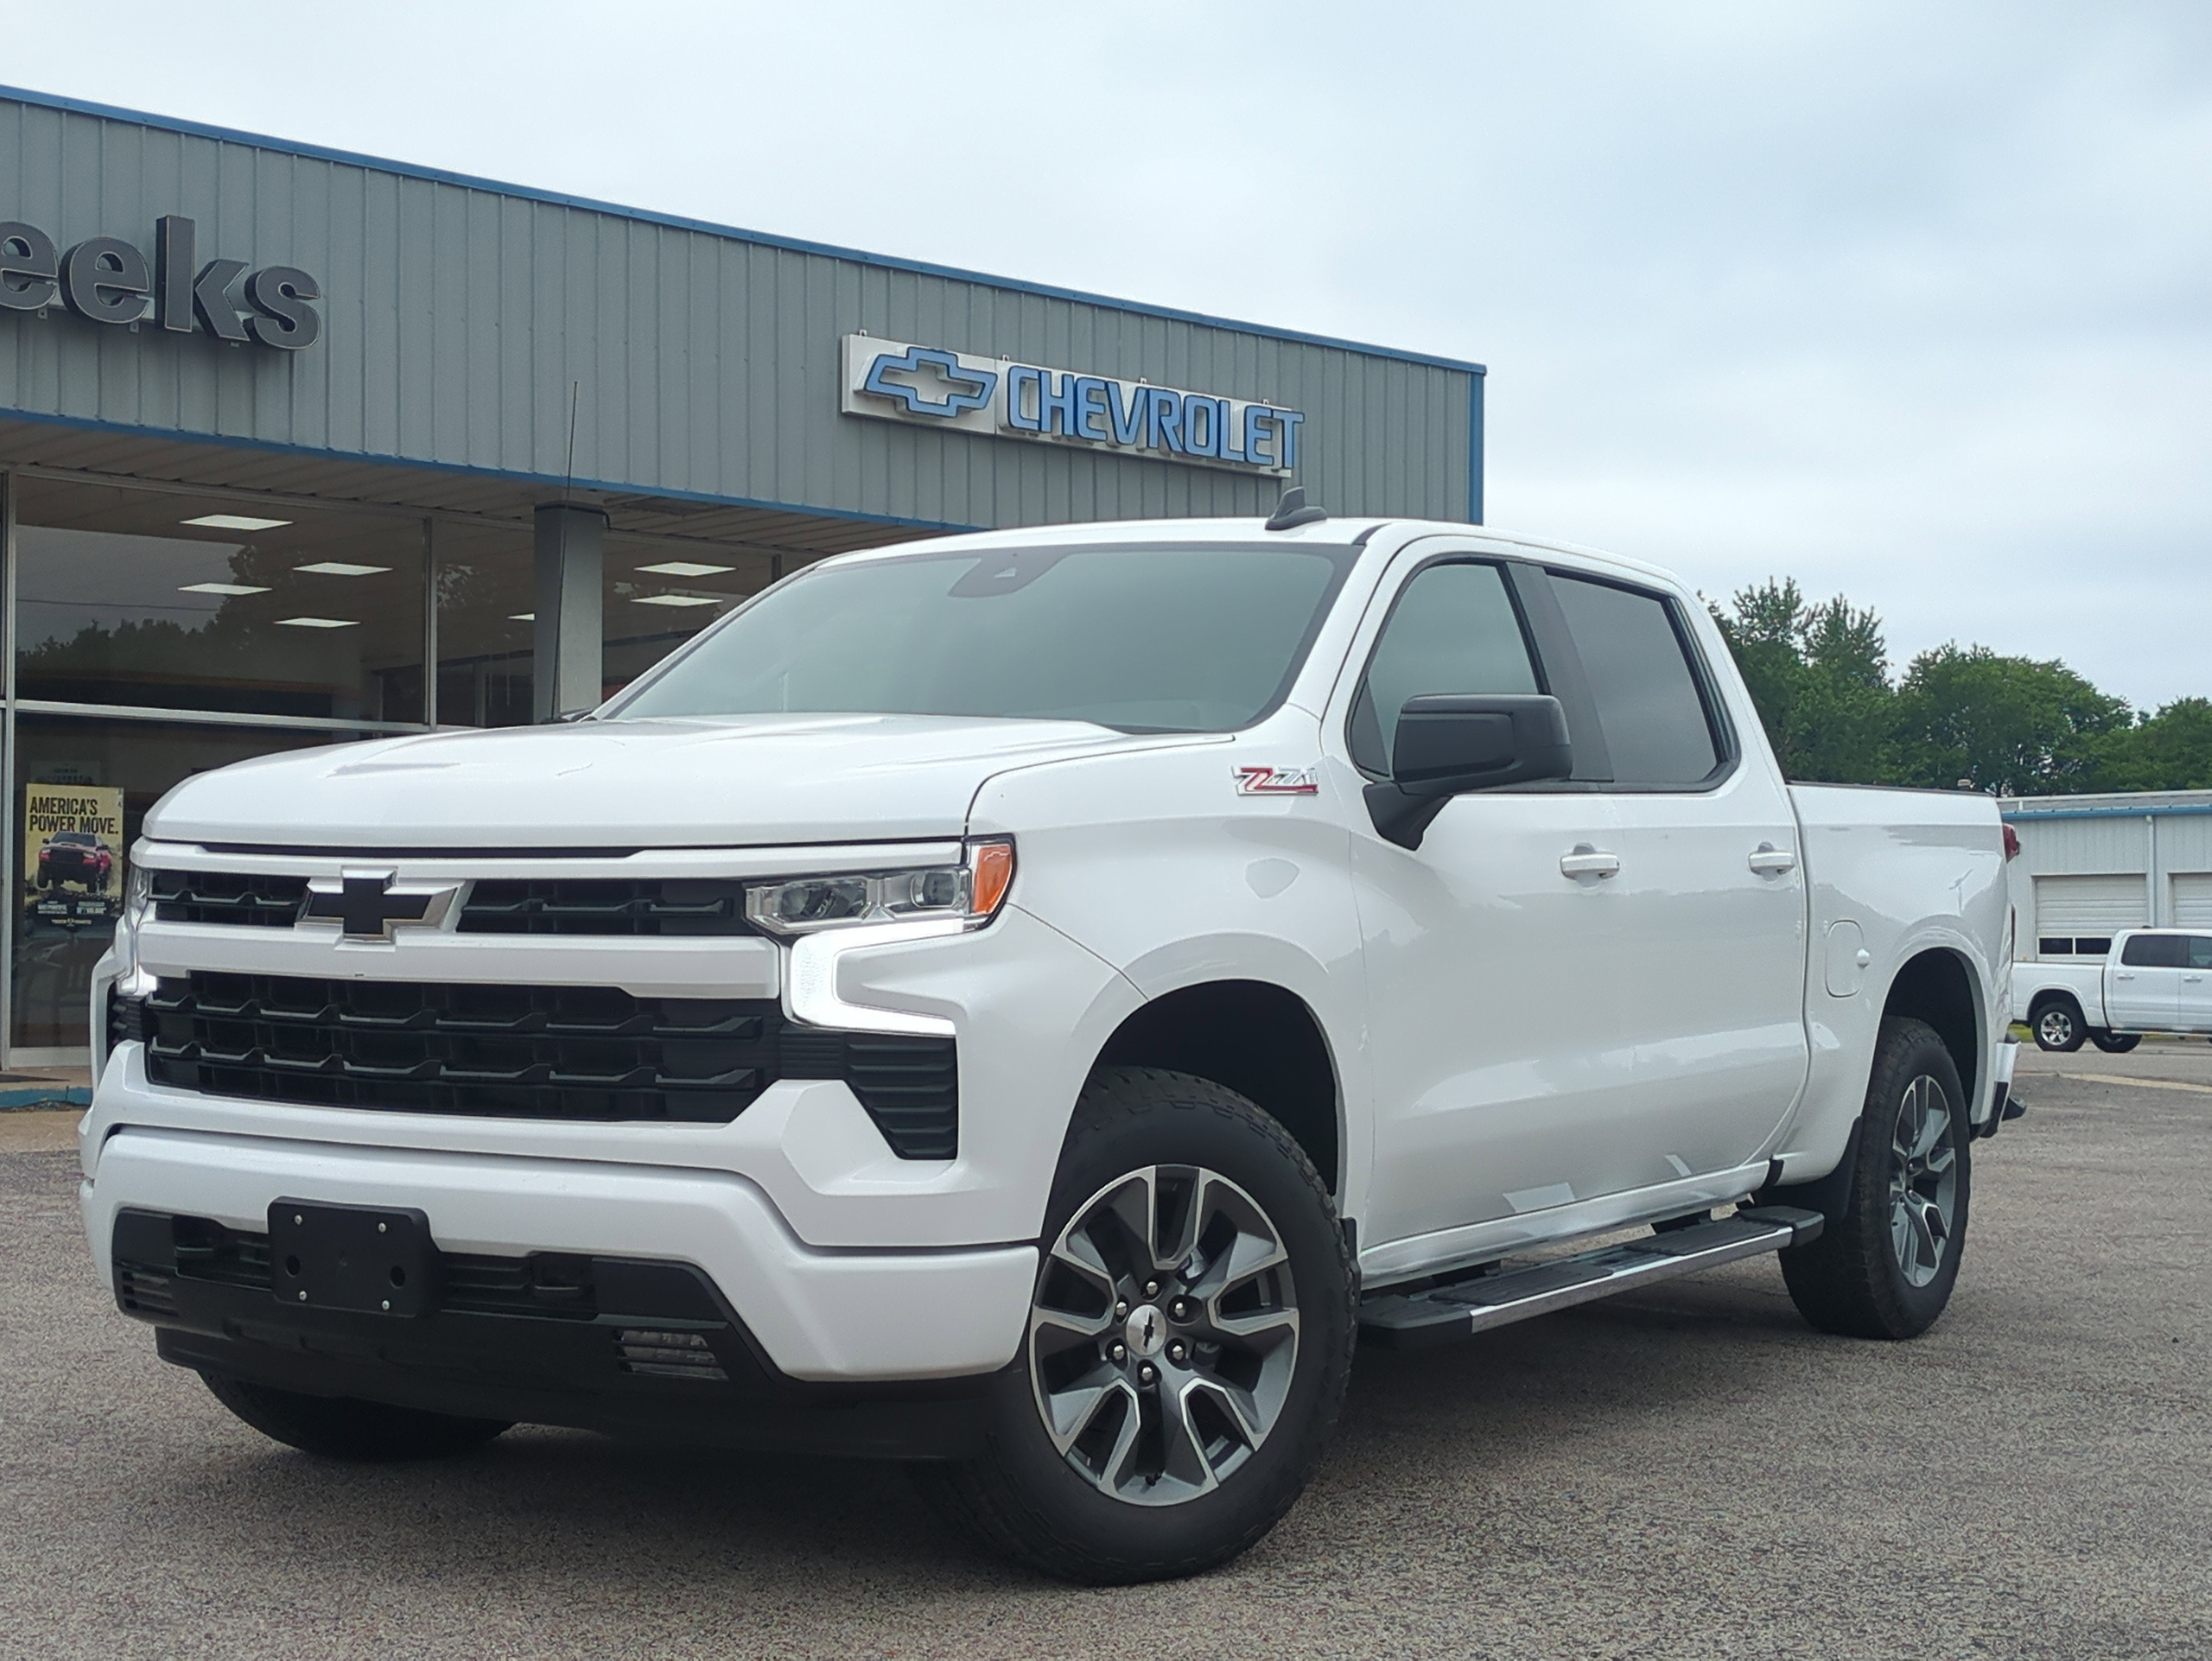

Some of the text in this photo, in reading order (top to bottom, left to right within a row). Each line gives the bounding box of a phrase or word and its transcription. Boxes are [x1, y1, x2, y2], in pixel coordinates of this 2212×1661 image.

[1007, 365, 1305, 468] CHEVROLET
[1231, 766, 1318, 796] Z71
[30, 797, 98, 815] AMERICA'S
[29, 815, 119, 834] POWER MOVE.
